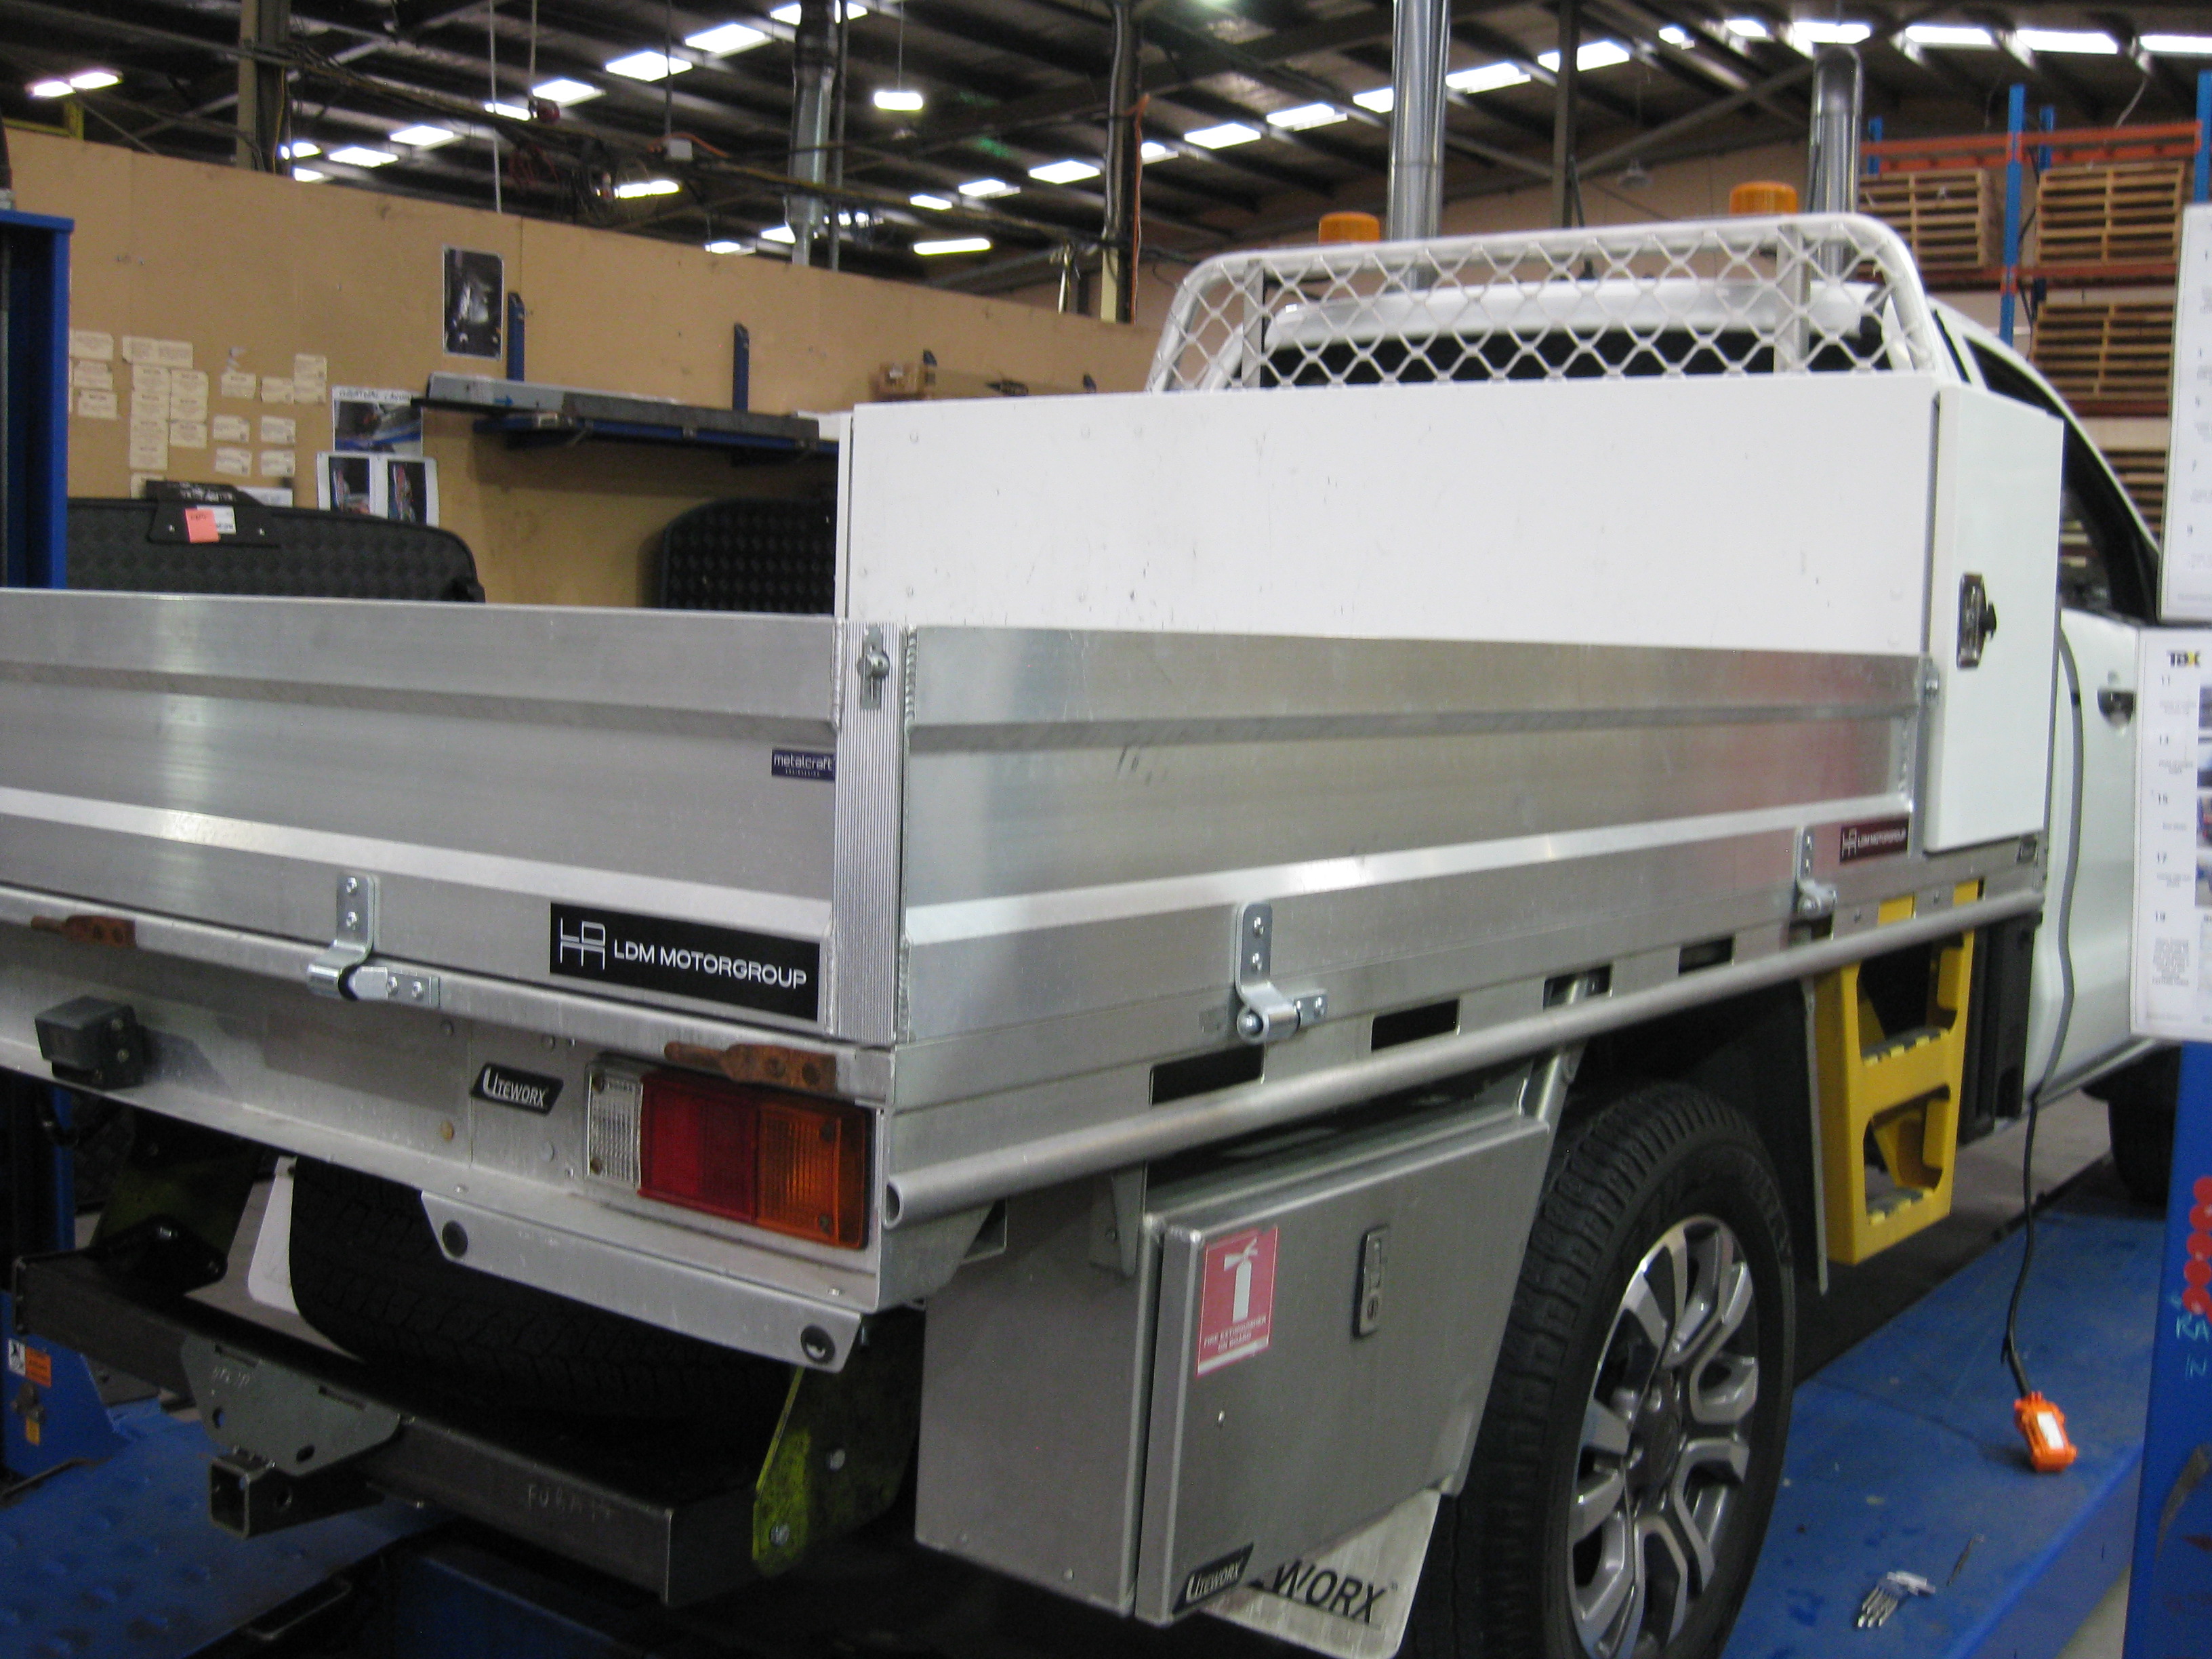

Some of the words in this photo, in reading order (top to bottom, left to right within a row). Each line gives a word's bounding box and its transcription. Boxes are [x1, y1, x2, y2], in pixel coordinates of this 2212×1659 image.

[773, 752, 833, 771] metalcraft
[613, 938, 655, 966] LDM
[659, 945, 807, 990] MOTORGROUP
[483, 1065, 549, 1109] UTEWORX
[1203, 1333, 1218, 1349] FIRE
[1219, 1315, 1267, 1340] EXTINGUISHER
[1217, 1339, 1228, 1353] ON
[1229, 1332, 1252, 1349] BOARD
